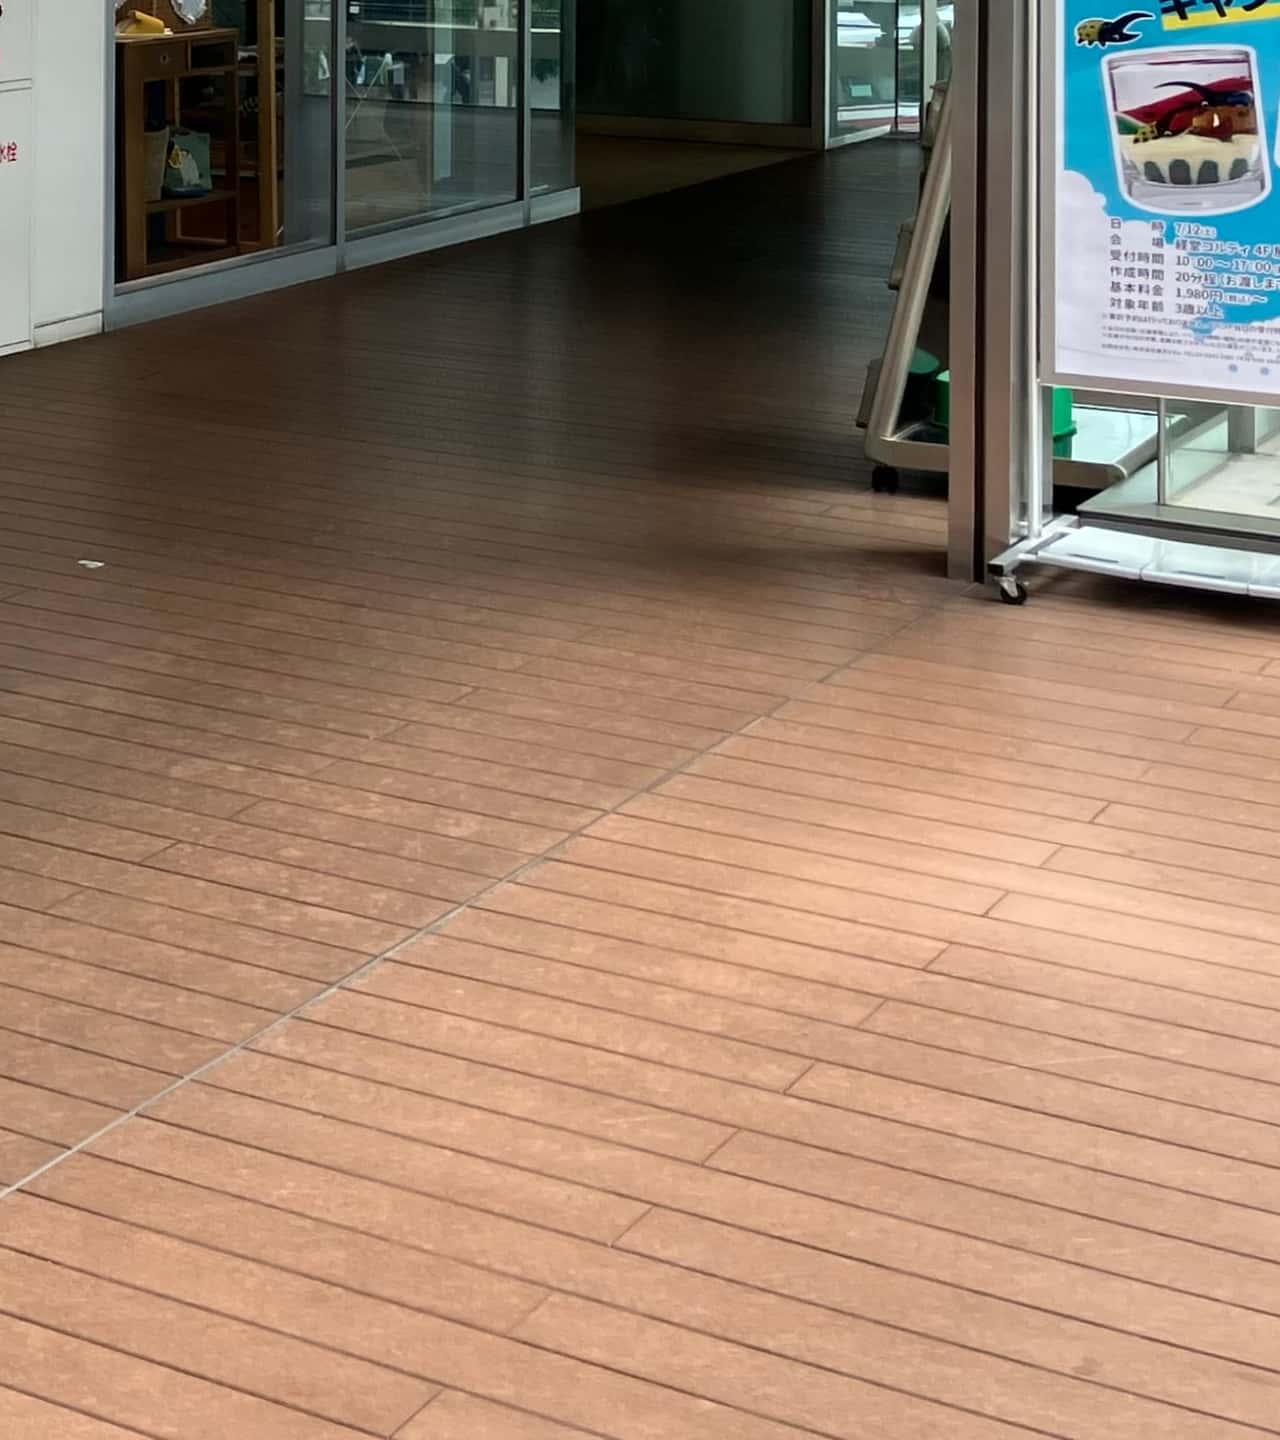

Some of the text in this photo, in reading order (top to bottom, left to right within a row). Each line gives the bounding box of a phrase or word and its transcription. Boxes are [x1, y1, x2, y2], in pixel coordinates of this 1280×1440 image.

[1176, 238, 1250, 256] 経堂コルティ
[1110, 250, 1165, 266] 受付時間
[1110, 281, 1165, 298] 基本料金
